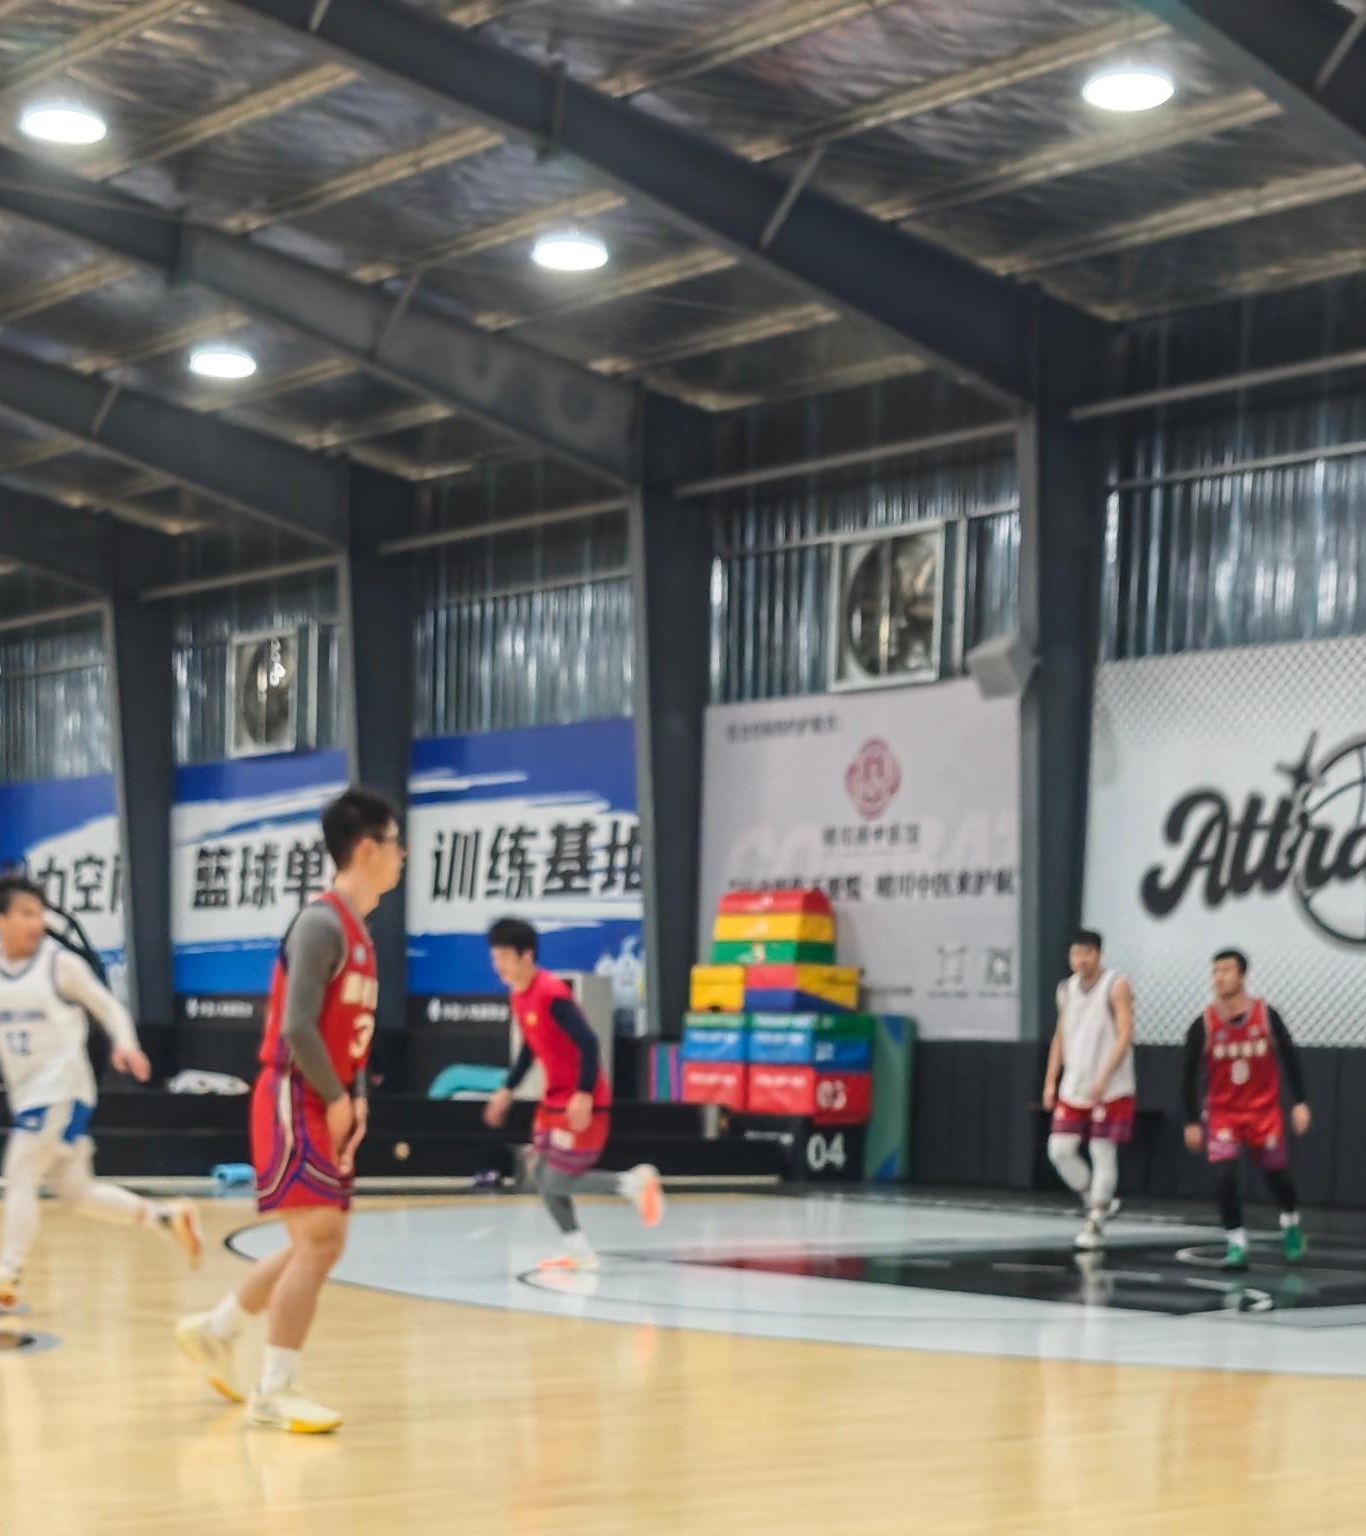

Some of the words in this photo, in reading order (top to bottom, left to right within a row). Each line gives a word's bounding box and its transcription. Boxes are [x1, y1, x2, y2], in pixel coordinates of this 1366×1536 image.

[25, 852, 124, 915] 力空
[432, 820, 643, 902] 训练基地
[806, 1133, 847, 1170] 04
